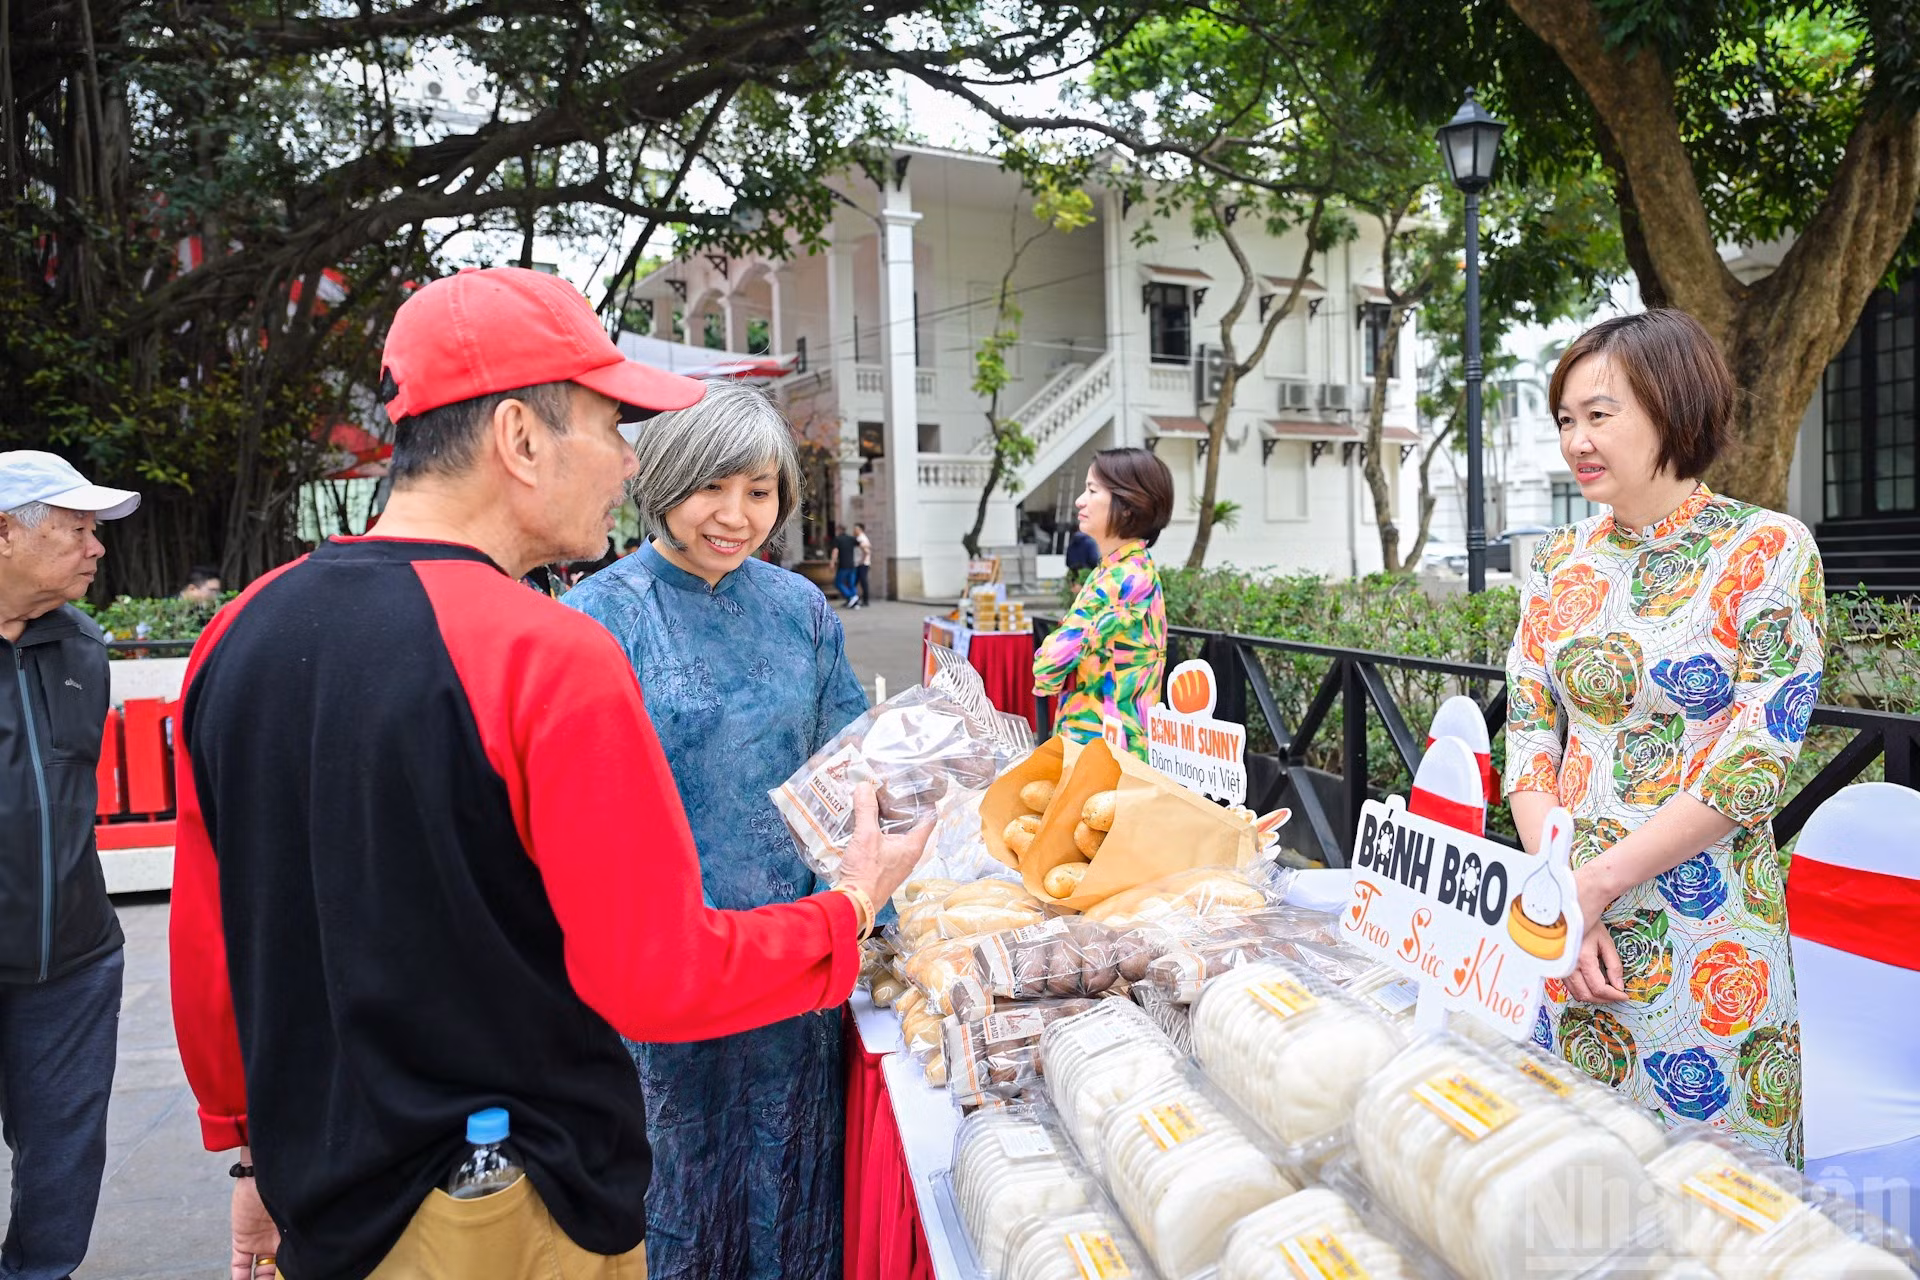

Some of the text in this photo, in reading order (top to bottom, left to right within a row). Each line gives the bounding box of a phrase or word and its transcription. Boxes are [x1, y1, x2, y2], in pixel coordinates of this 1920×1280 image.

[1151, 713, 1178, 747] BÁNH
[1198, 727, 1239, 763] SUNNY
[812, 776, 845, 813] FRESH DAILY
[1208, 765, 1217, 791] vị
[1219, 766, 1241, 798] Việt
[1357, 809, 1508, 926] BÁNH BAO
[1345, 880, 1391, 949] Trao
[1396, 907, 1445, 978] Sức
